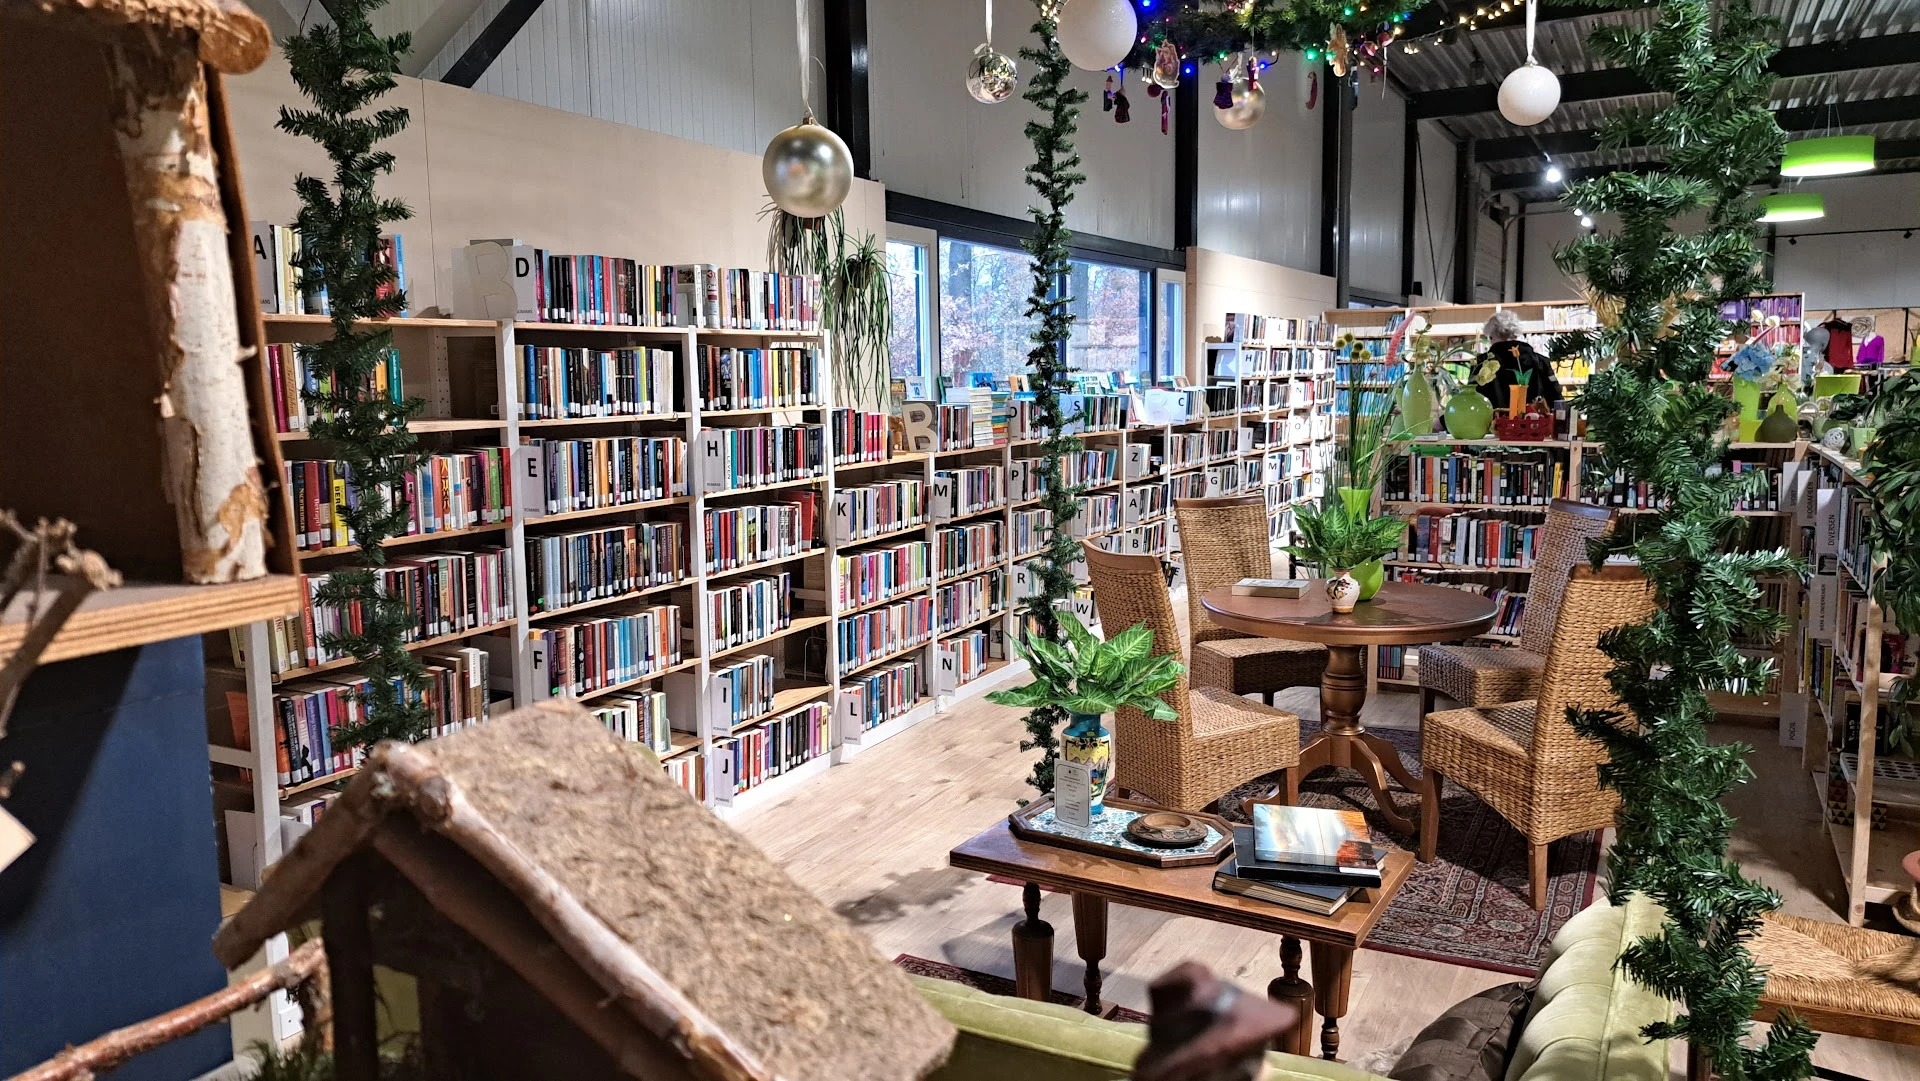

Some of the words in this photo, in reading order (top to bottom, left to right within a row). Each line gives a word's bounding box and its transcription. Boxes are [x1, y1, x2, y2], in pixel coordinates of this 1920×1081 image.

[254, 234, 267, 260] A
[515, 257, 530, 278] D
[1073, 400, 1081, 411] S
[1178, 397, 1185, 407] C
[902, 402, 938, 452] B
[707, 440, 718, 457] H
[1131, 452, 1139, 463] Z
[527, 457, 538, 478] E
[1268, 462, 1277, 470] M
[1011, 470, 1019, 481] P
[1210, 476, 1218, 485] G
[934, 483, 948, 497] M
[837, 502, 847, 517] K
[1129, 498, 1138, 508] A
[1132, 539, 1139, 548] B
[1017, 573, 1026, 583] R
[1076, 602, 1088, 614] W
[533, 650, 543, 670] F
[942, 658, 952, 671] N
[722, 687, 727, 703] I
[850, 702, 858, 716] L
[722, 758, 729, 774] J
